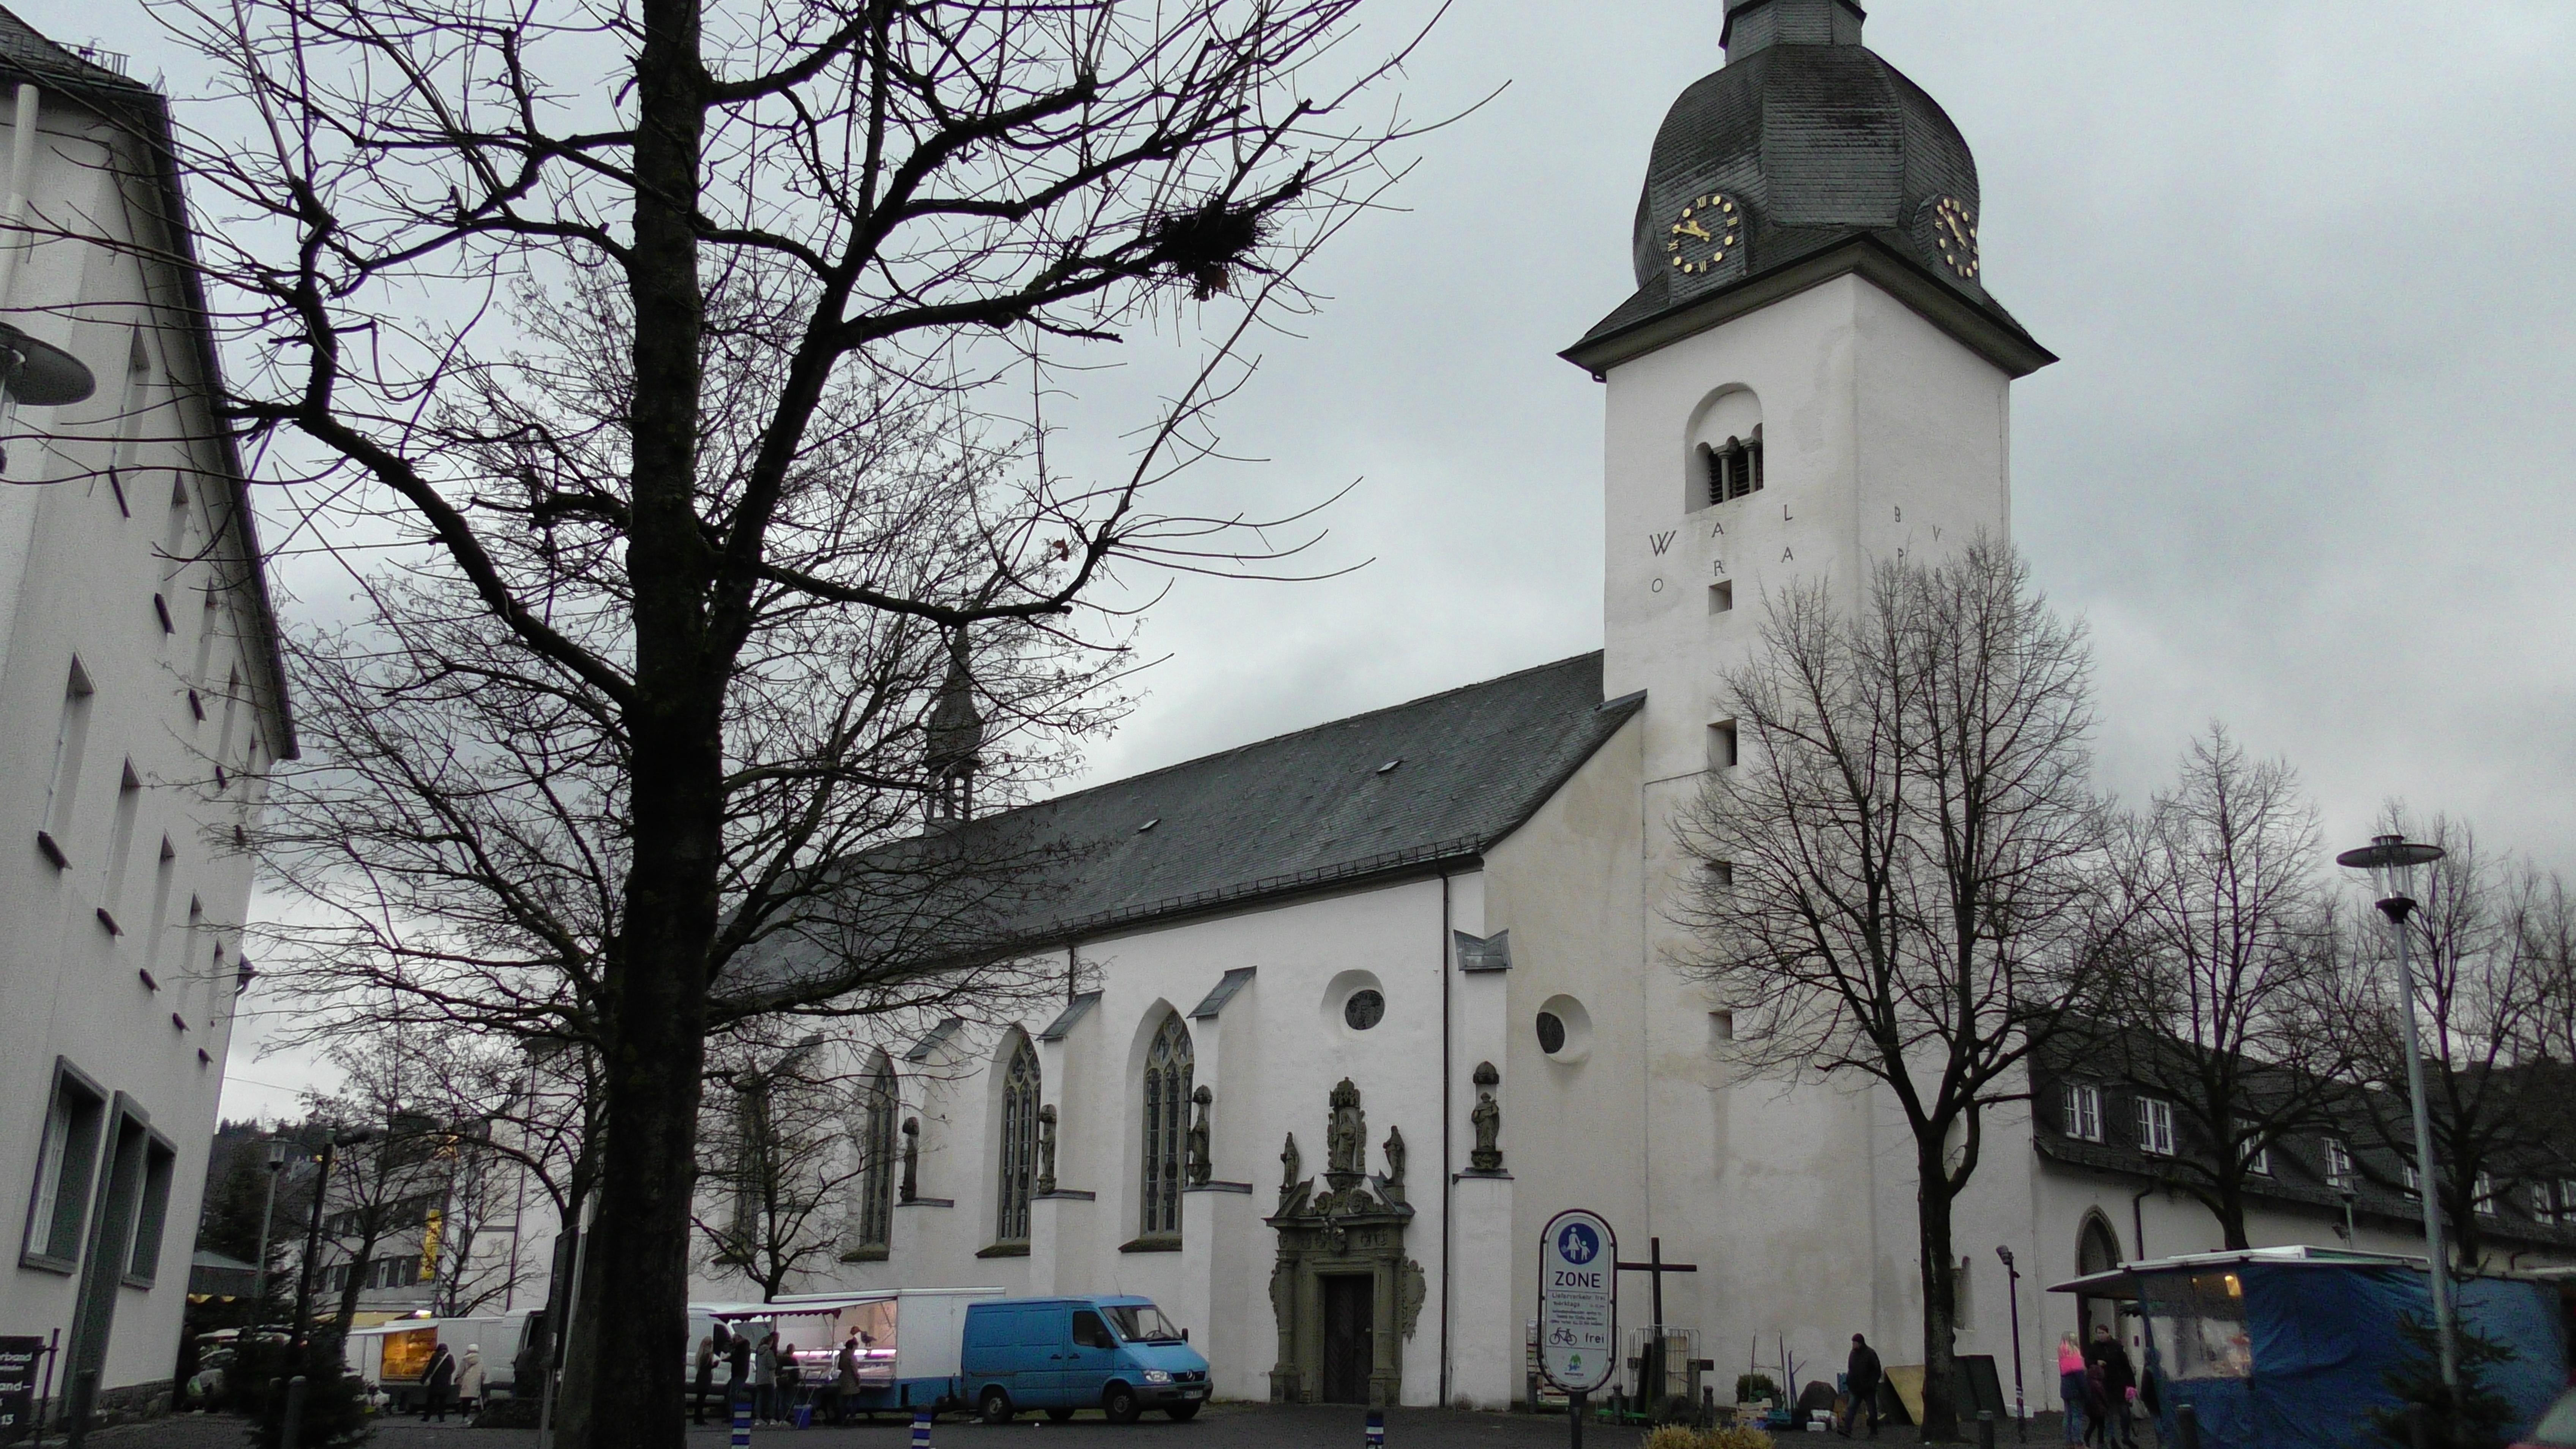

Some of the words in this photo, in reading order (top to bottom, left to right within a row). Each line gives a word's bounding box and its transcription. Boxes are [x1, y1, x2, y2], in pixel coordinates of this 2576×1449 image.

[1697, 196, 1706, 208] XII
[1699, 260, 1706, 273] VI
[1555, 1271, 1601, 1288] ZONE
[1585, 1332, 1604, 1343] frei
